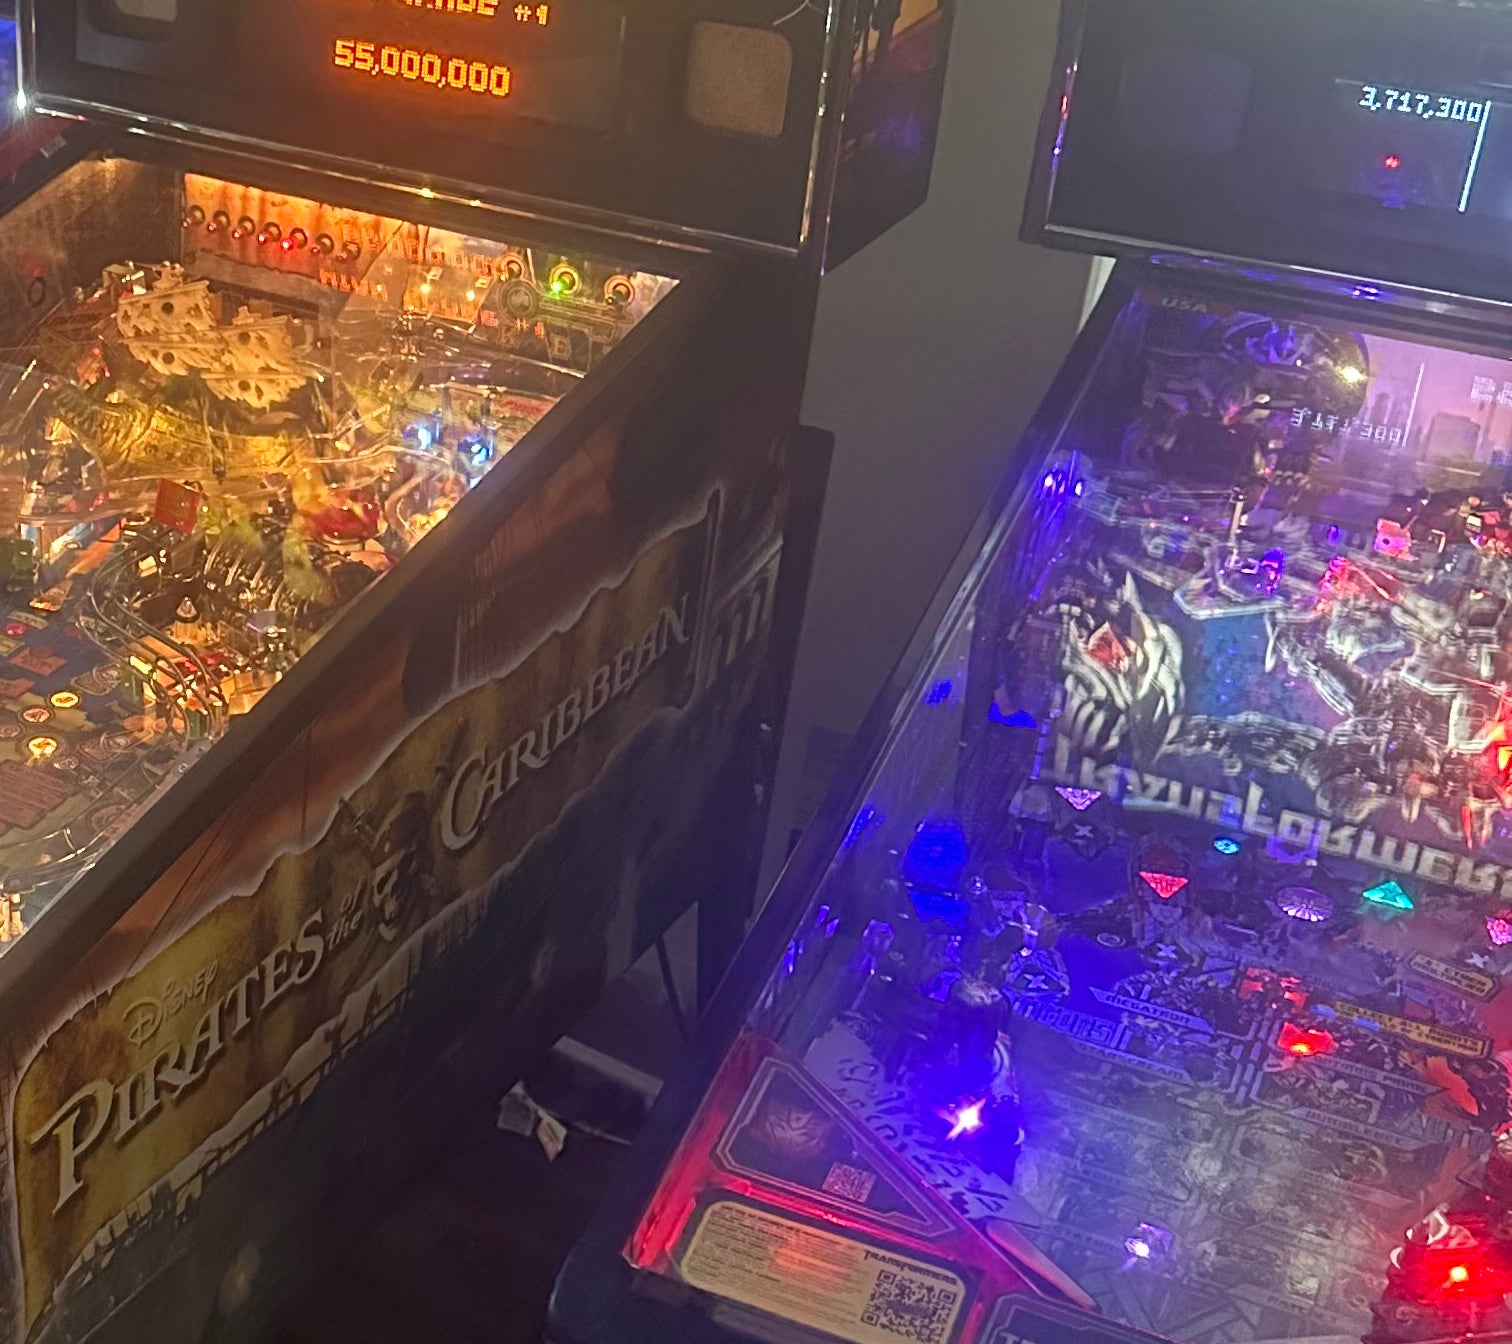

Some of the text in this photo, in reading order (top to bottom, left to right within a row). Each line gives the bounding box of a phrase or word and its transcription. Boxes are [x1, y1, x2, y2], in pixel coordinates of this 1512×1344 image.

[514, 3, 549, 26] #1
[334, 39, 512, 97] 55,000,000
[1359, 85, 1483, 123] 3,717,300
[31, 907, 326, 1217] PIRATES
[440, 593, 689, 851] CARIBBEAN
